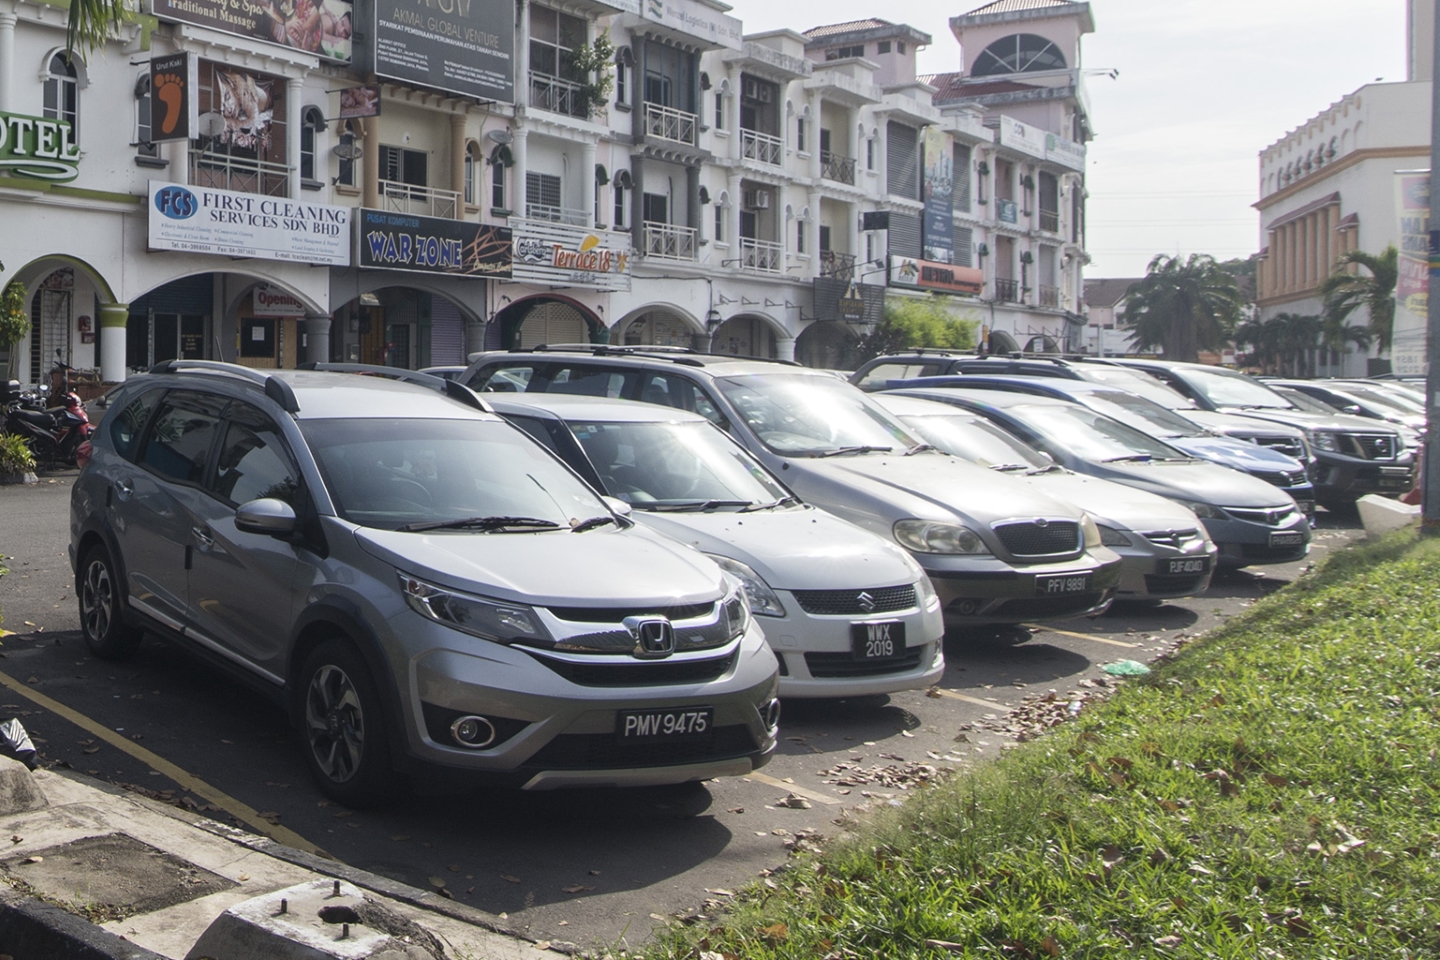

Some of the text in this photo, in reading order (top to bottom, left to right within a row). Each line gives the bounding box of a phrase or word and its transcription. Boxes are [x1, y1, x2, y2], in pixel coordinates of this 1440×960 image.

[219, 8, 257, 30] Massage
[393, 8, 499, 49] AKMAL GLOBAL VENTURE
[686, 12, 709, 31] Logistics
[155, 60, 170, 71] Urut
[160, 190, 193, 217] FCS
[203, 192, 346, 225] FIRST CLEANING
[210, 209, 340, 236] SERVICES SDN BHD
[366, 213, 420, 228] PUSAT KOMPUTER
[367, 230, 463, 269] WAR ZONE
[516, 237, 547, 258] Carlsberg
[552, 244, 612, 271] Terrace 18
[258, 291, 303, 309] Opening
[1048, 577, 1086, 593] PFV 9891
[866, 624, 894, 657] WWX 2019
[625, 712, 708, 737] PMV 9475
